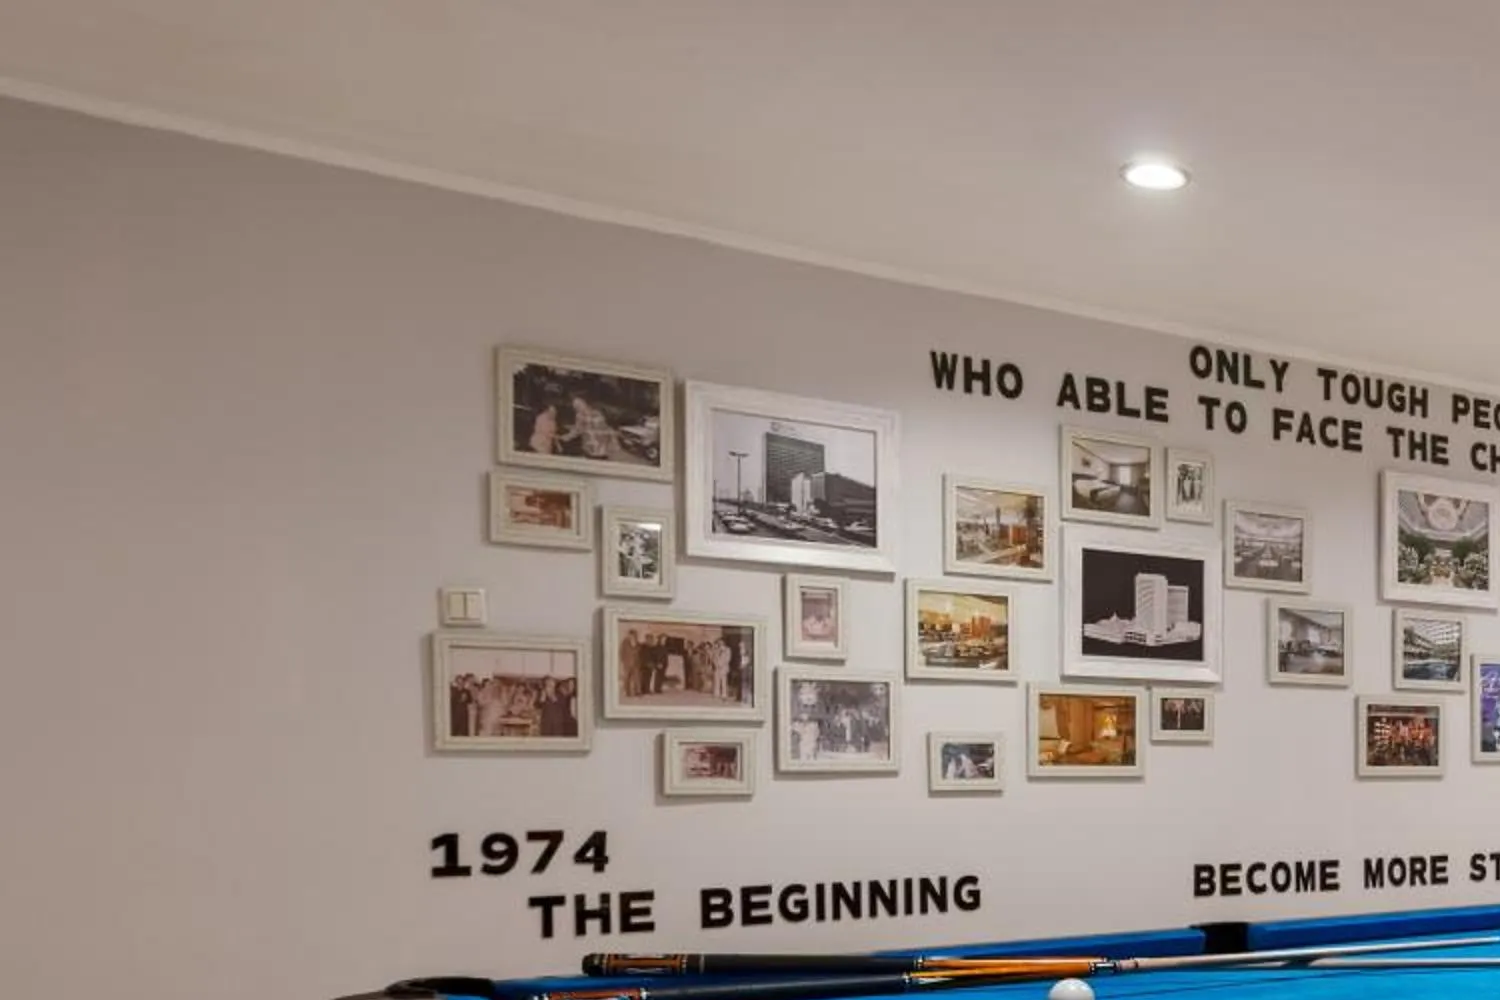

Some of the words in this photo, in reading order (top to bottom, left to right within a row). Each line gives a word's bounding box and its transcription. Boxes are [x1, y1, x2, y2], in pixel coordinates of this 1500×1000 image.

[930, 351, 1024, 400] WHO
[1056, 373, 1169, 423] ABLE
[1197, 395, 1247, 434] TO
[1272, 407, 1363, 453] FACE
[1386, 426, 1449, 466] THE
[1189, 345, 1289, 393] ONLY
[1317, 367, 1429, 419] TOUGH
[431, 829, 609, 878] 1974
[1193, 859, 1340, 897] BECOME
[1363, 855, 1449, 889] MORE
[527, 890, 655, 939] THE
[700, 875, 981, 929] BEGINNING
